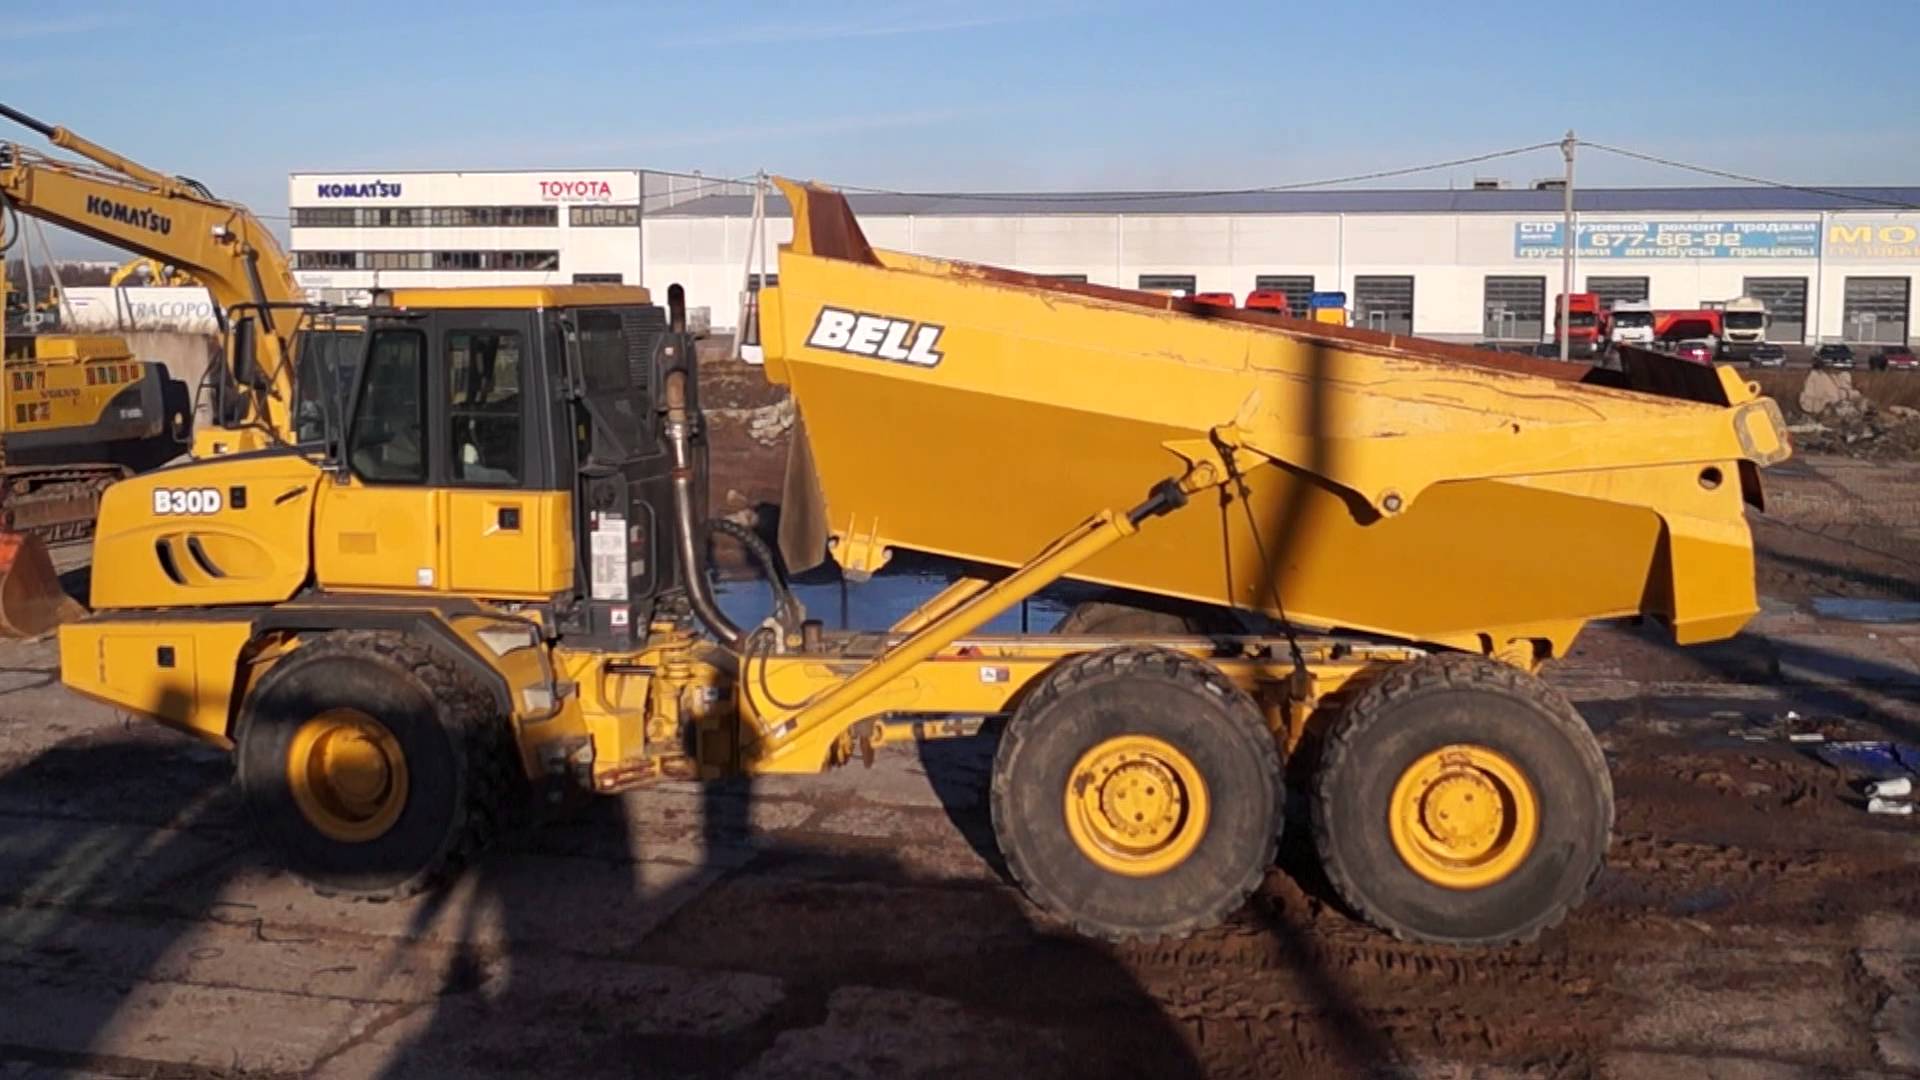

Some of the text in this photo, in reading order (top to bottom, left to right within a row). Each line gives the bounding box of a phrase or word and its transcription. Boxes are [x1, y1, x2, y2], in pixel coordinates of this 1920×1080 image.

[317, 179, 402, 198] KOMATSU
[539, 181, 612, 196] TOYOTA
[86, 194, 172, 235] KOMATSU
[1520, 222, 1556, 233] СТО
[1569, 222, 1650, 235] узовной
[805, 305, 945, 368] BELL
[153, 488, 222, 515] B30D
